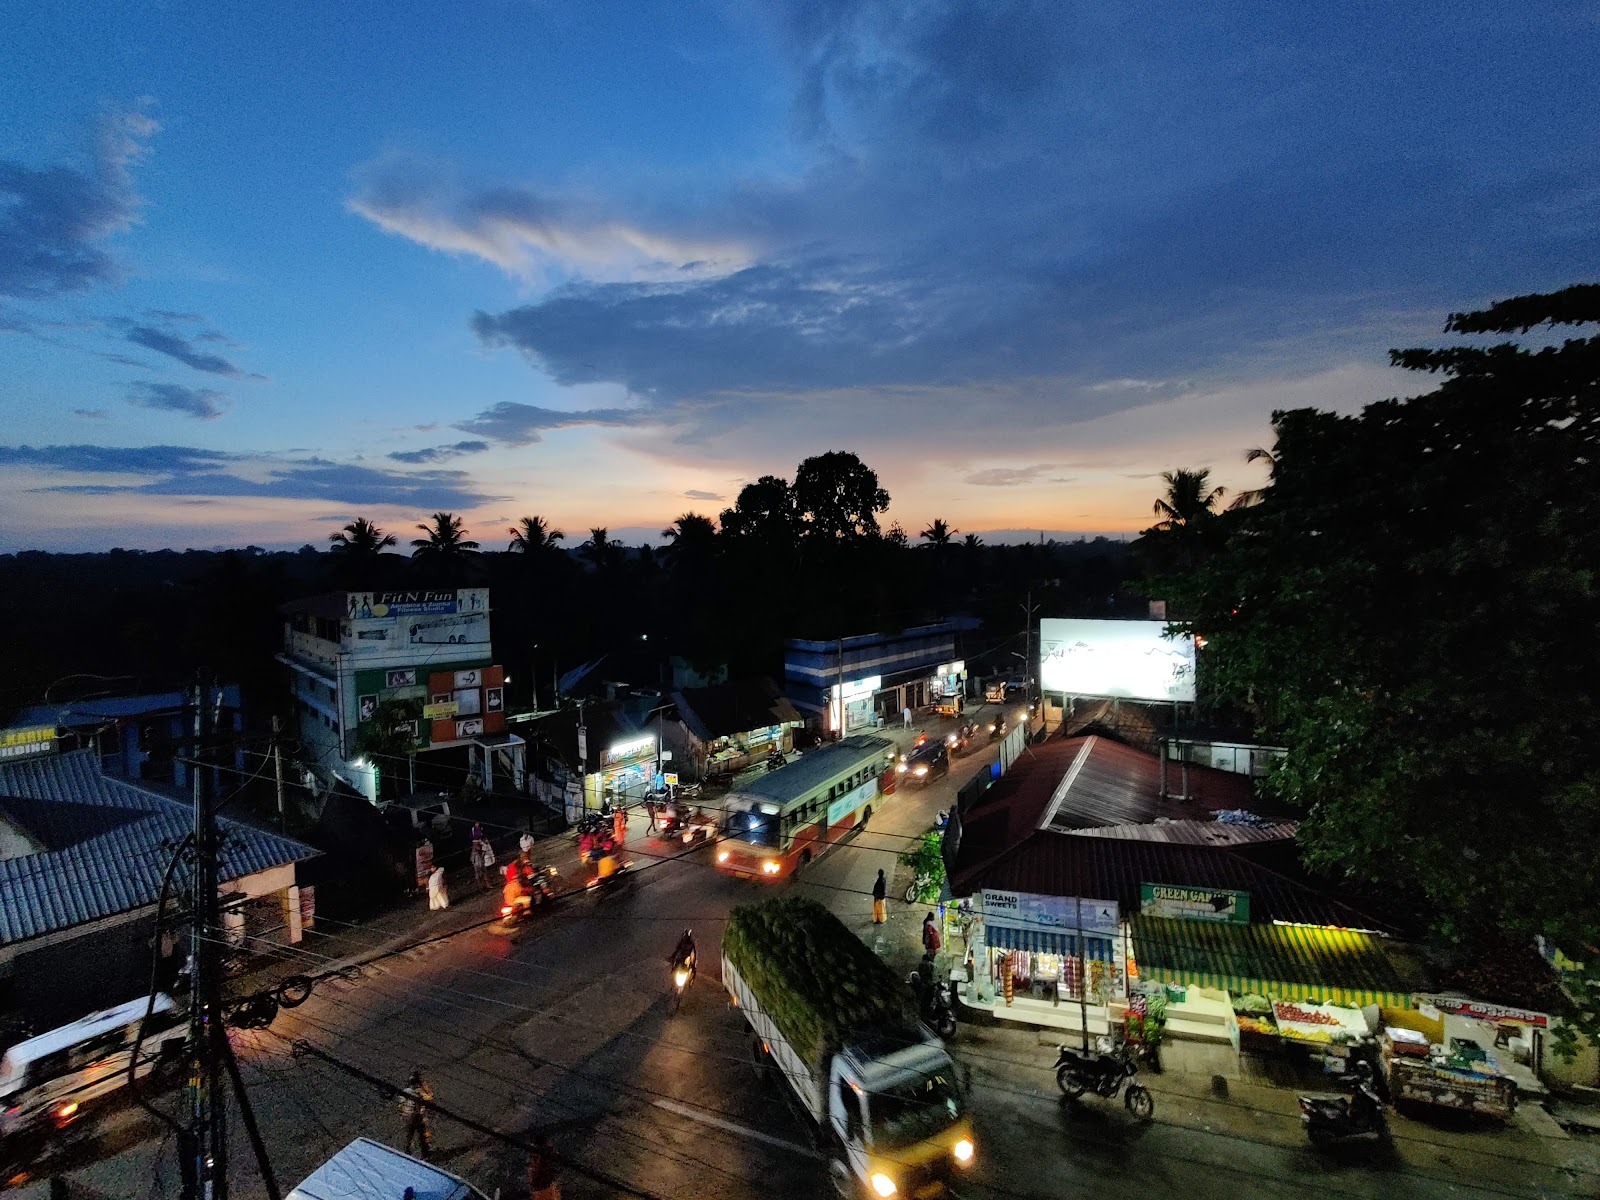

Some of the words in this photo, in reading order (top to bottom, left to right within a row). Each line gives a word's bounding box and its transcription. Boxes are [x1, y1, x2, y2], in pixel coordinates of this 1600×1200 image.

[380, 592, 403, 604] Fit
[404, 592, 420, 602] N
[423, 591, 453, 602] Fun
[984, 893, 1018, 903] GRAND
[1152, 886, 1188, 901] GREEN
[984, 900, 1018, 910] SWEETS
